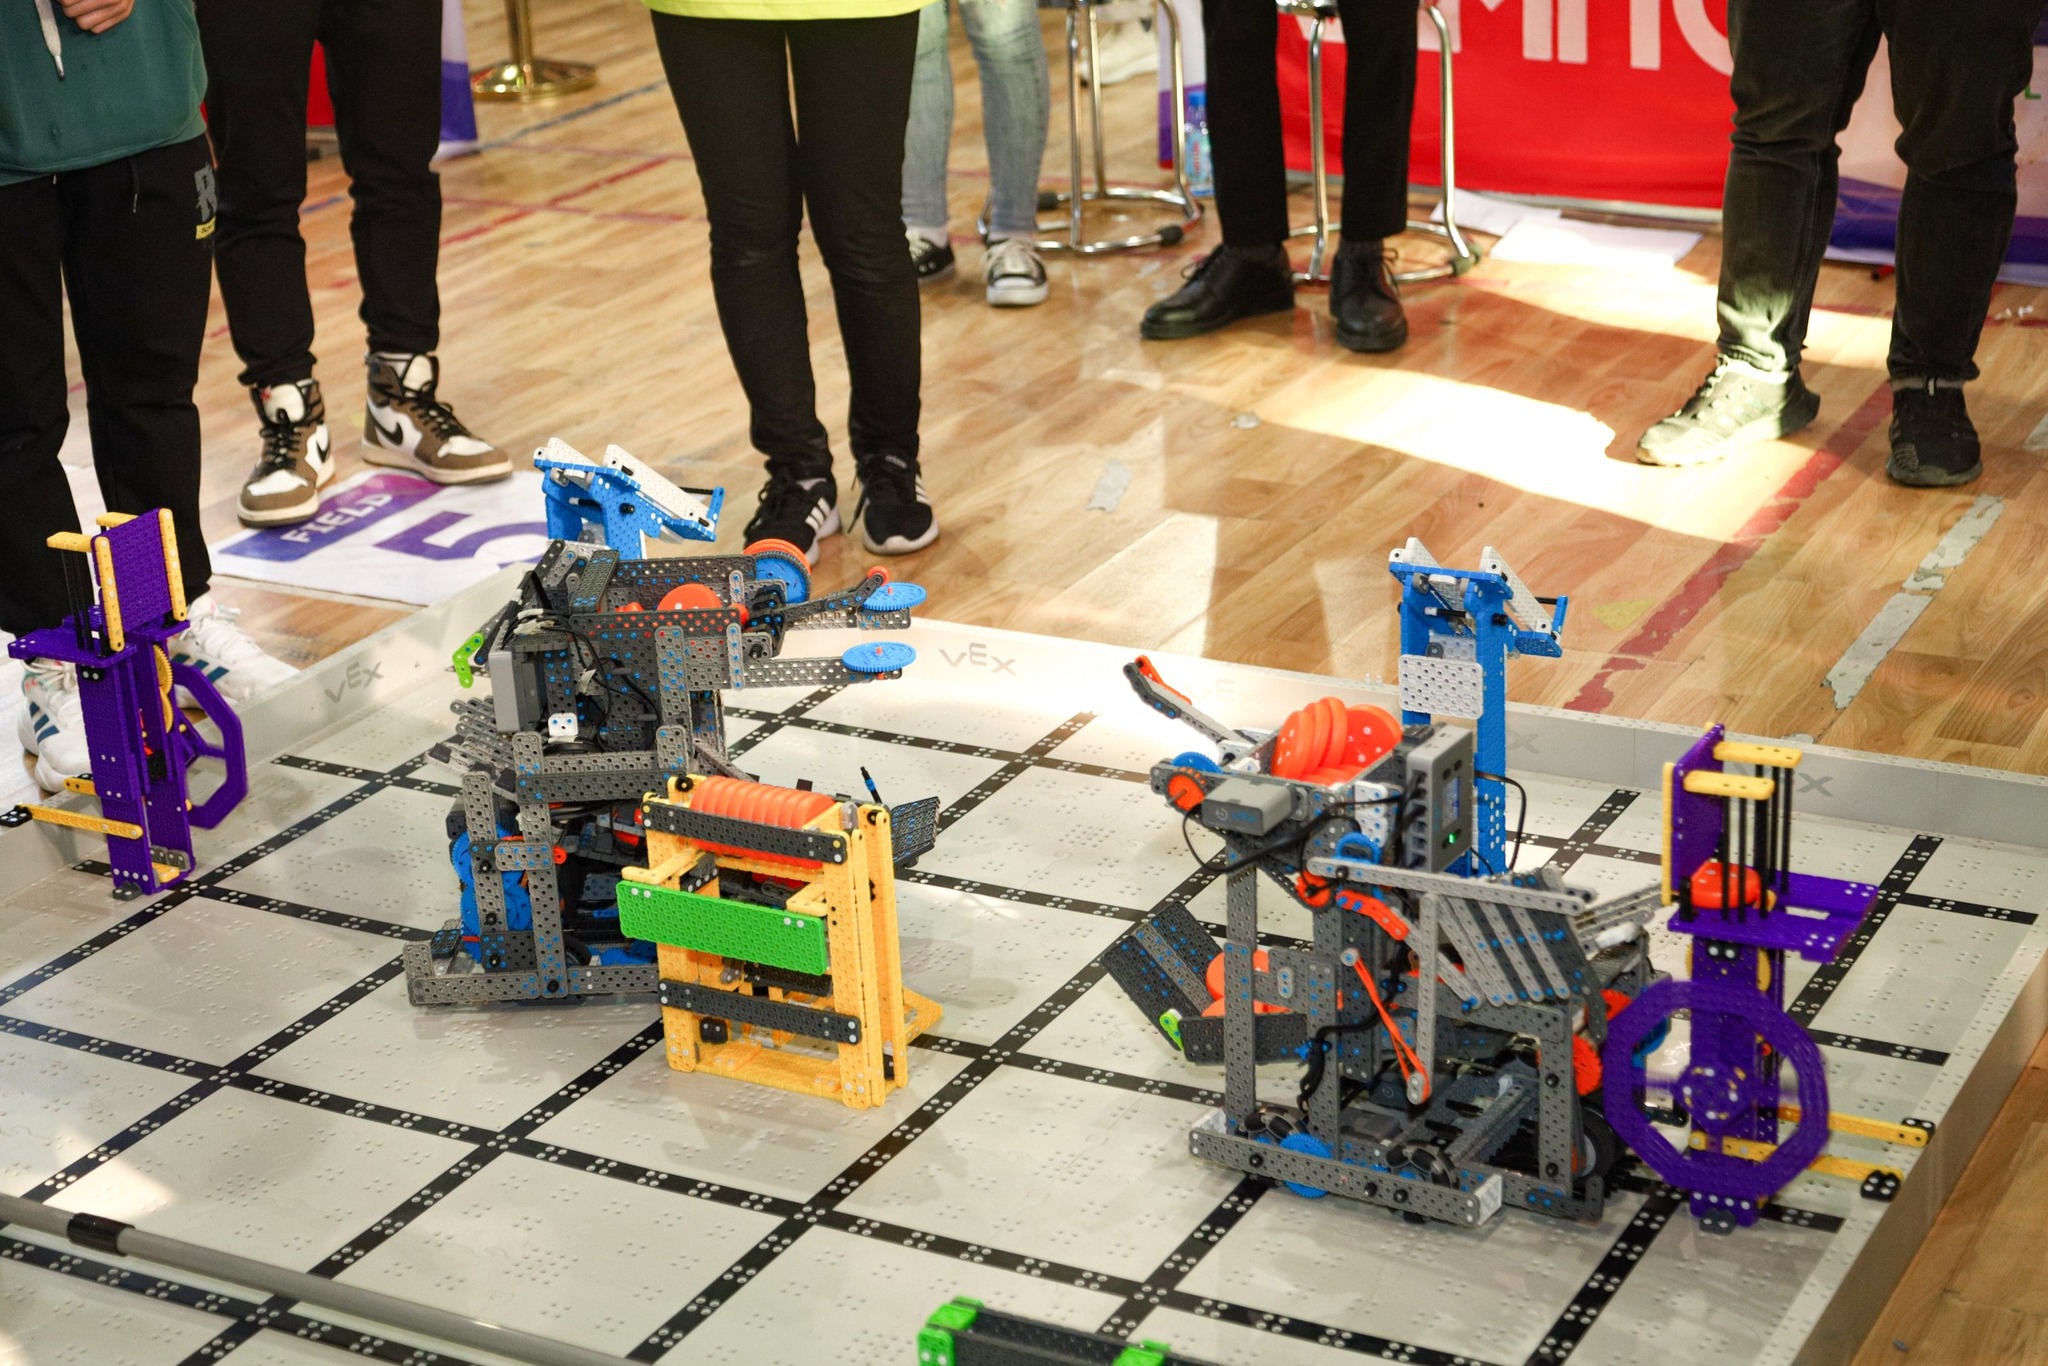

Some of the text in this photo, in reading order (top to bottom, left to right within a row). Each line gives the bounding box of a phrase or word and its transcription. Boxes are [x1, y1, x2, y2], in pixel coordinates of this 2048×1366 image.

[280, 492, 394, 544] FIELD
[938, 642, 1017, 676] VEX
[324, 661, 384, 703] VEX
